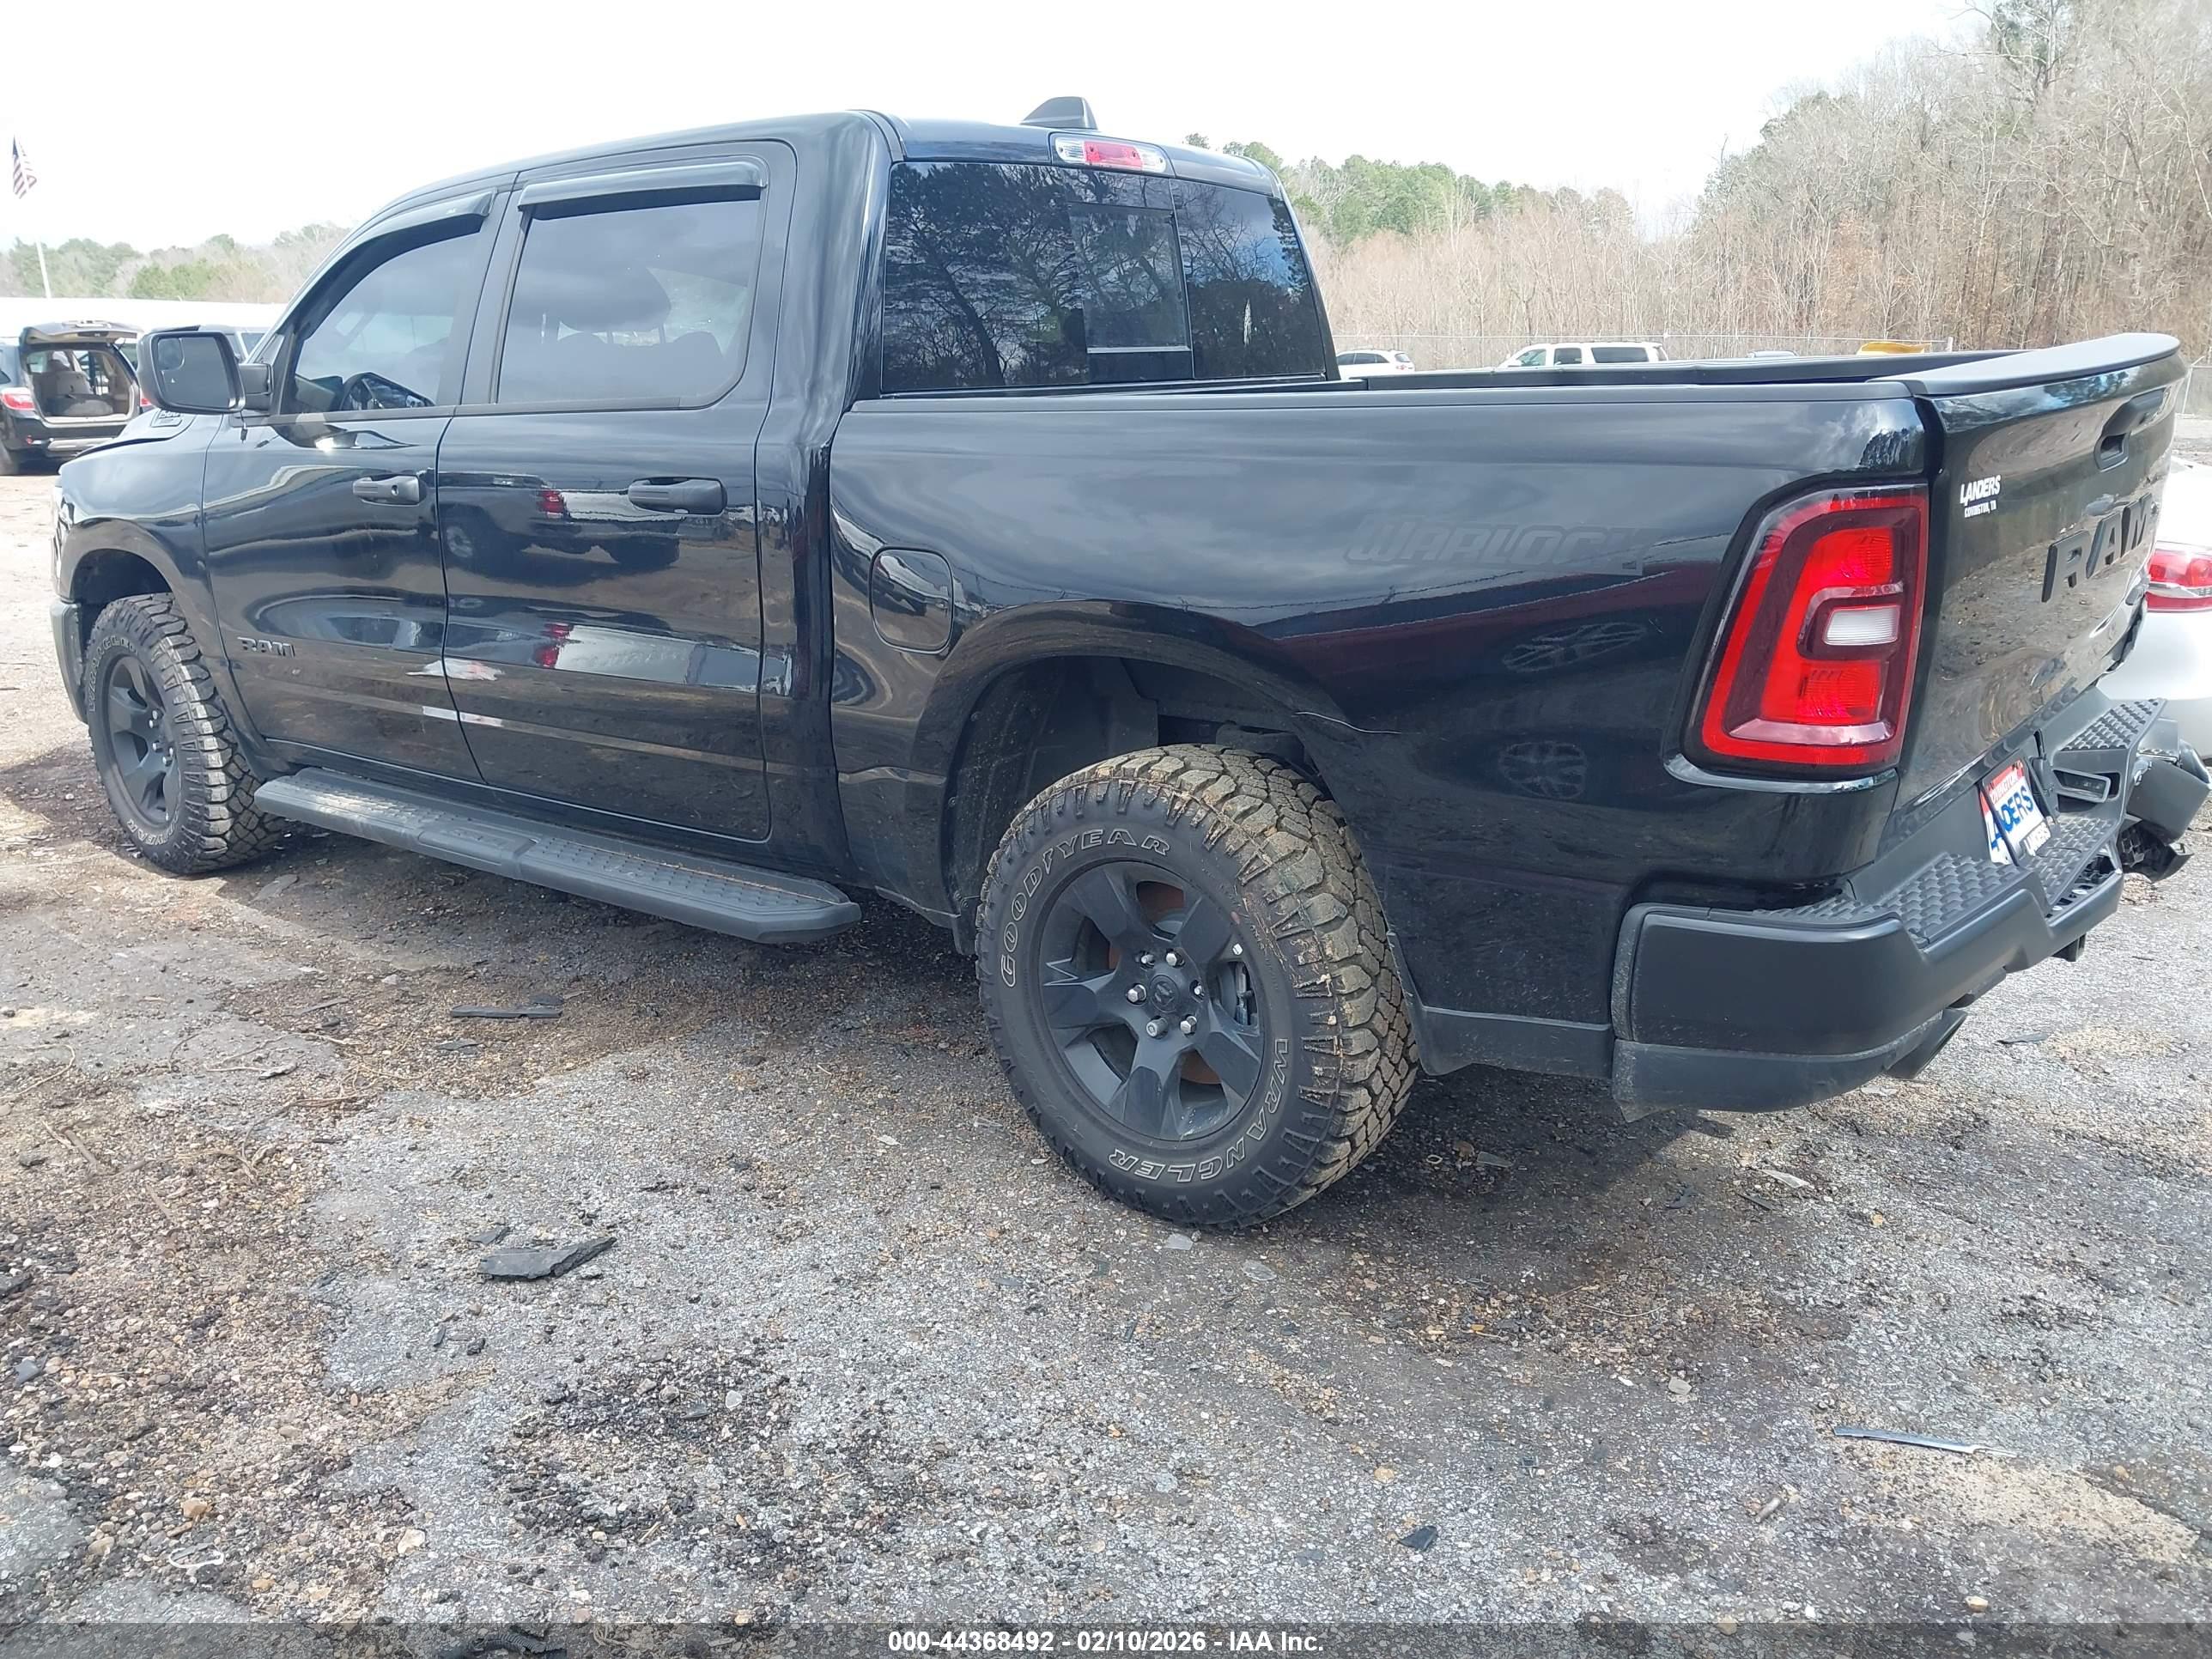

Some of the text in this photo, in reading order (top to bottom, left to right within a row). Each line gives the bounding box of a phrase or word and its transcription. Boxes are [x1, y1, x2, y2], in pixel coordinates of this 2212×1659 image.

[1960, 474, 2002, 507] LANDERS
[1343, 518, 1657, 576] WARLOCK
[2041, 492, 2154, 603] RAM
[237, 636, 295, 657] RAM
[1001, 829, 1170, 988] GOODYEAR
[1109, 1038, 1288, 1182] WRANGLER
